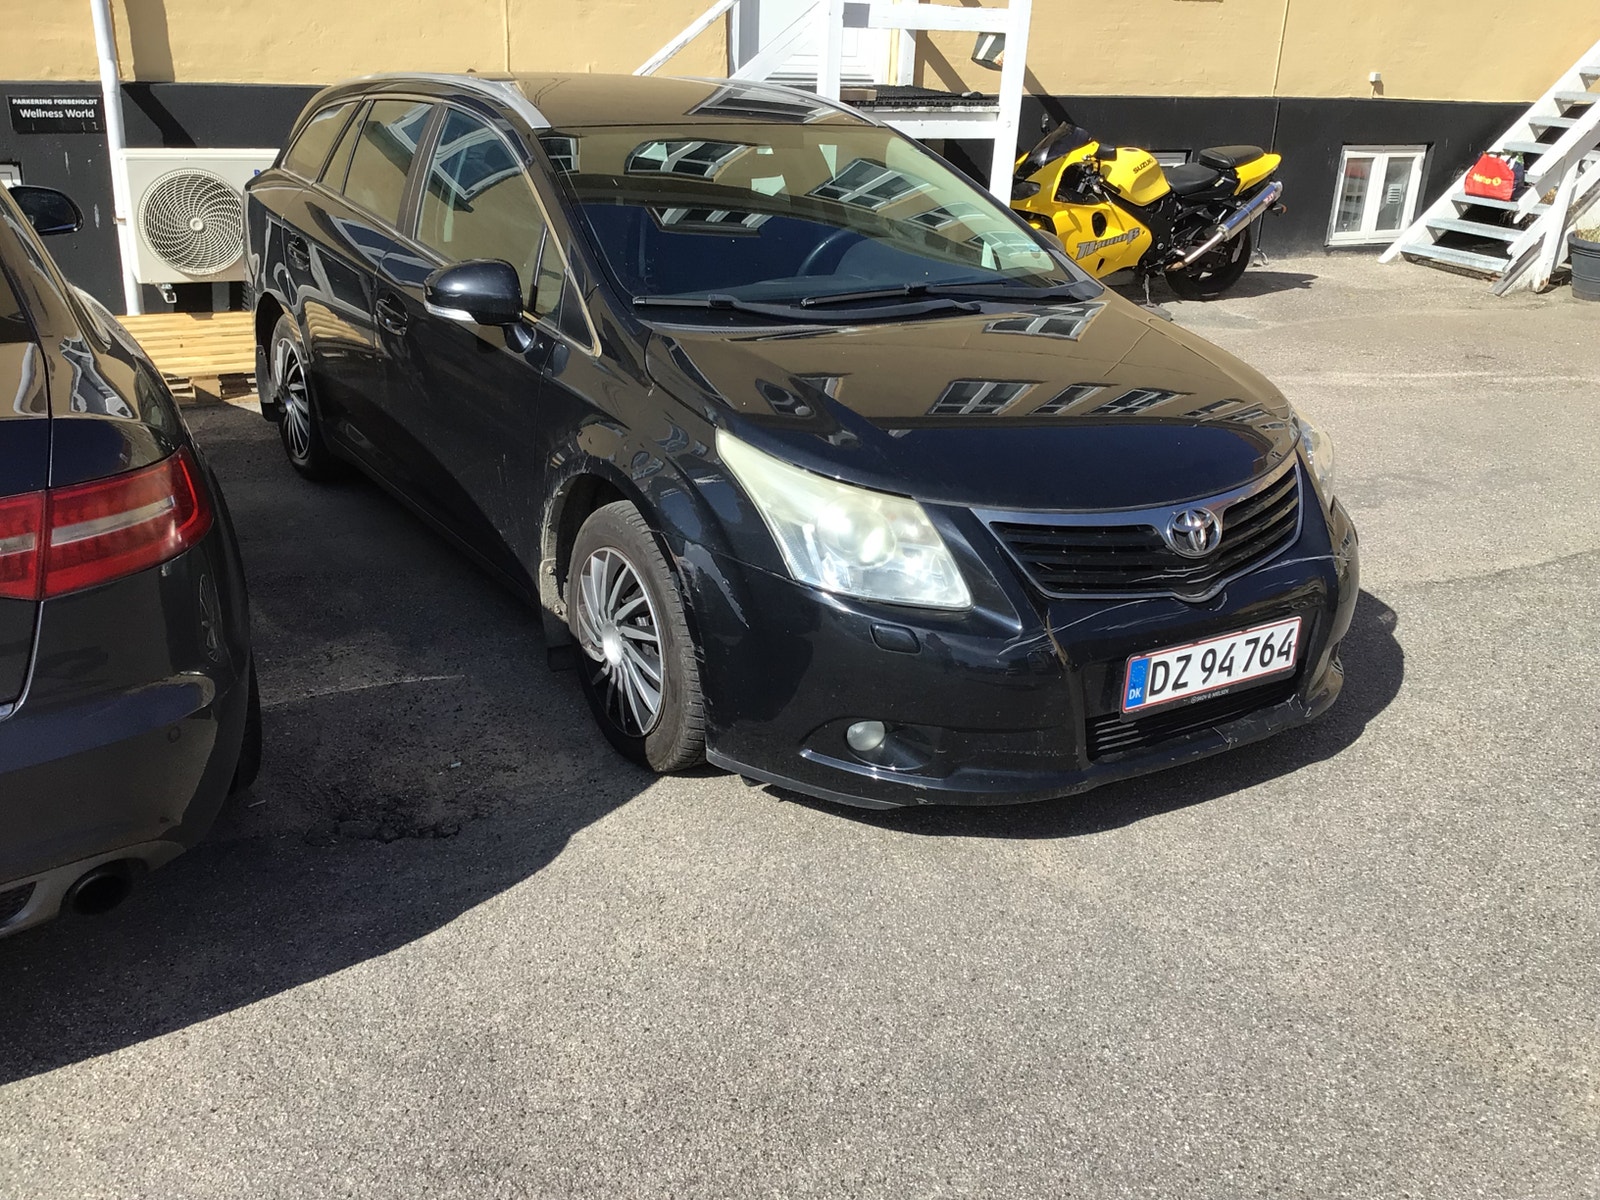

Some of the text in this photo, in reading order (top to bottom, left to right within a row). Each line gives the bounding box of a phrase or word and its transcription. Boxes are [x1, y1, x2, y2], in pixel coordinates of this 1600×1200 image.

[20, 109, 95, 118] Wellness World
[1149, 628, 1295, 697] DZ 94 764
[1128, 687, 1142, 700] DK
